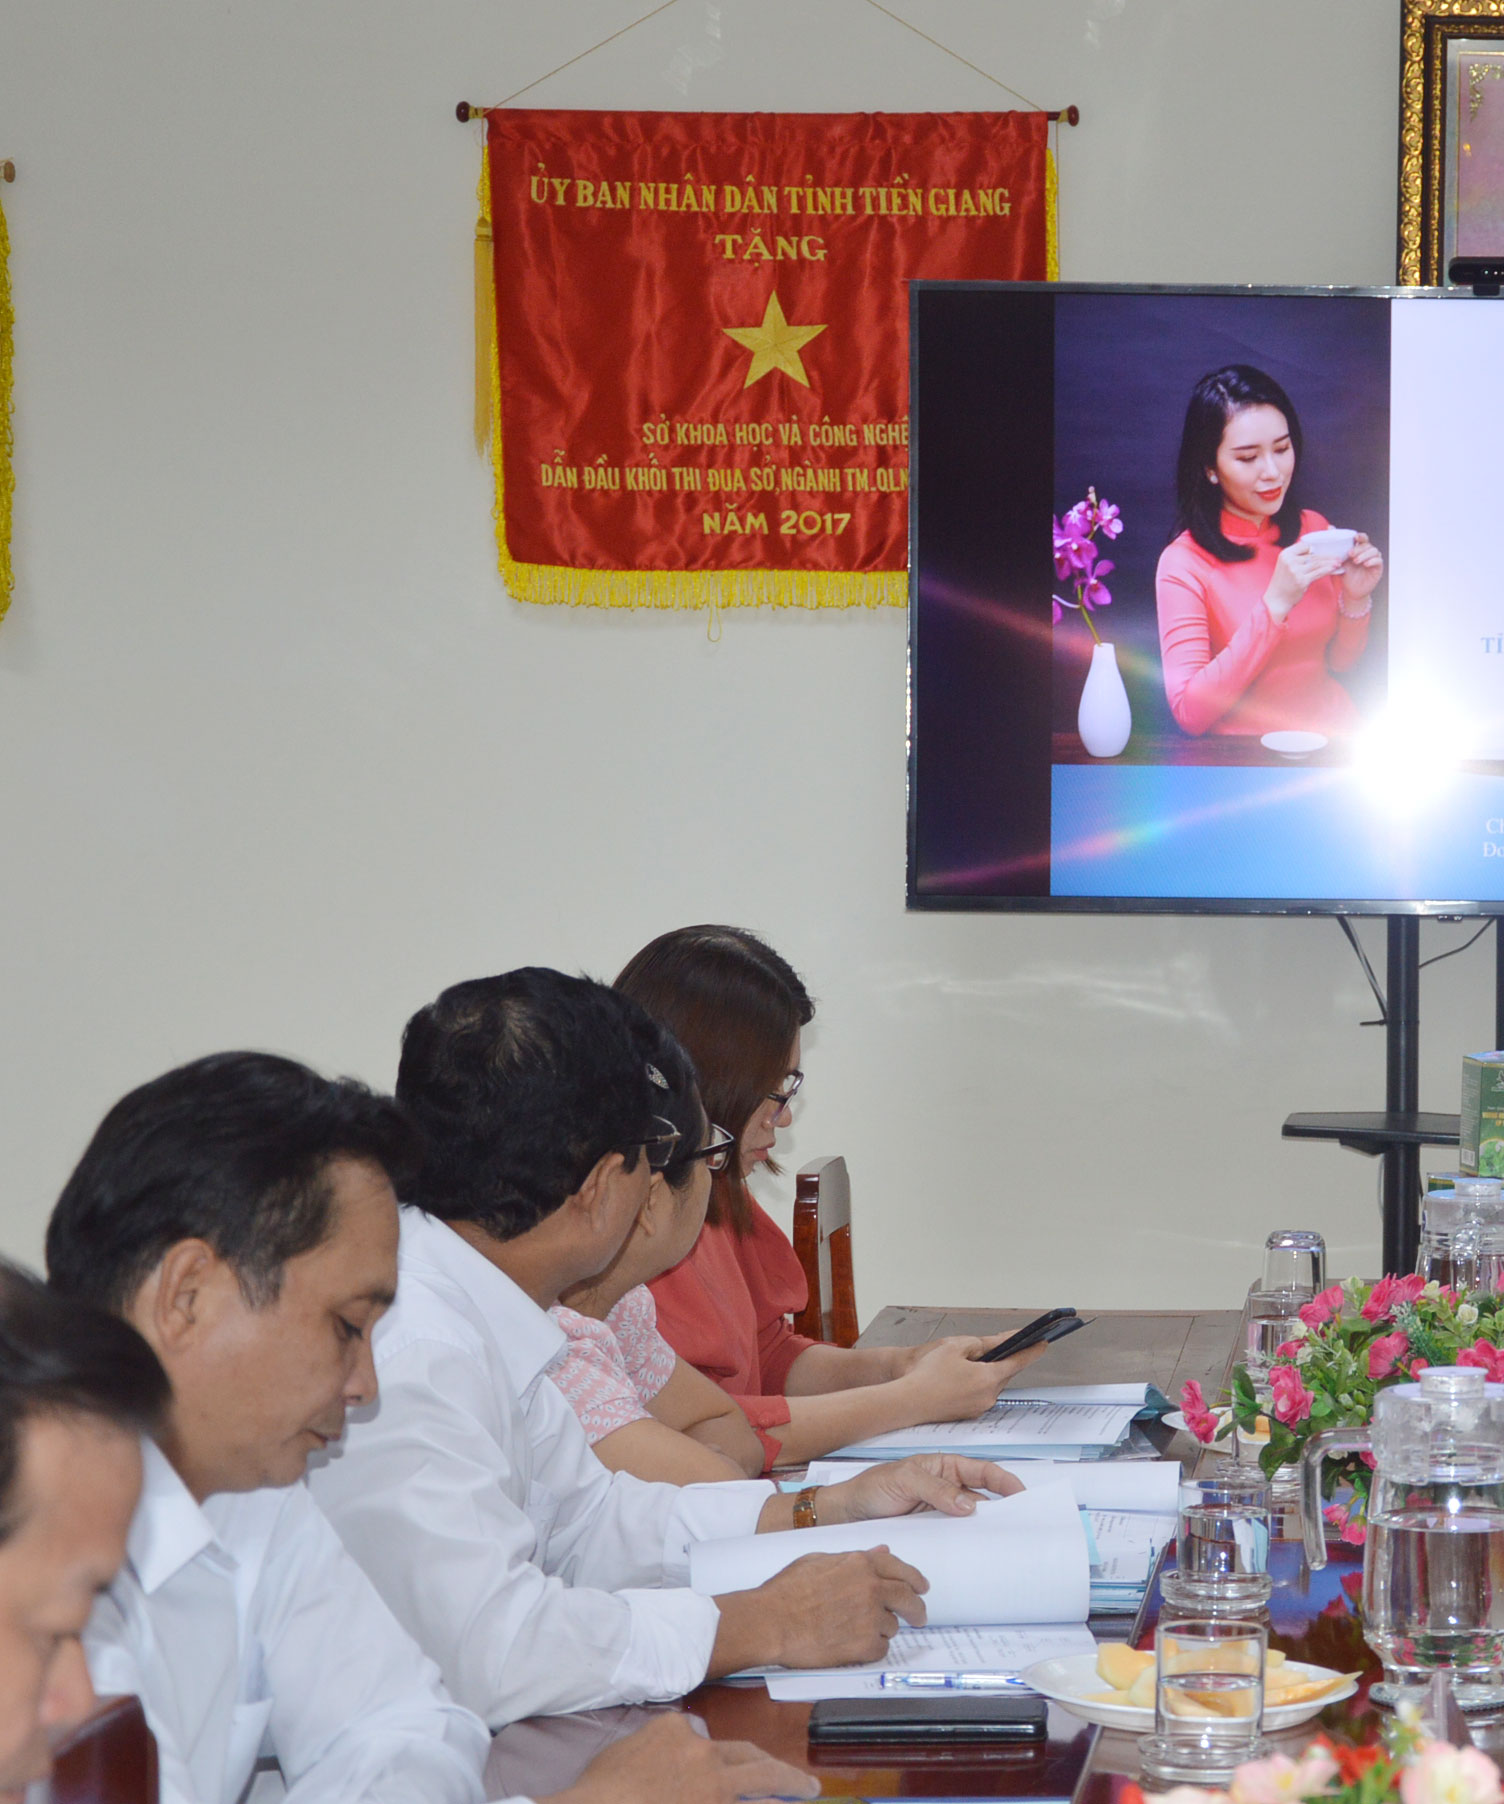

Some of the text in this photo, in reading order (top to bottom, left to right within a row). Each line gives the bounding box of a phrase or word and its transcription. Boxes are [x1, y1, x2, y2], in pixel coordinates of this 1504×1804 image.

[532, 163, 1010, 216] ỦY BAN NHÂN DÂN TỈNH TIỀN GIANG
[715, 228, 827, 266] TẶNG
[643, 414, 669, 444] SỞ
[677, 424, 728, 445] KHOA
[736, 424, 773, 450] HỌC
[779, 416, 801, 445] VÀ
[810, 416, 857, 446] CÔNG
[542, 450, 577, 488] DẪN
[584, 455, 619, 489] ĐẦU
[626, 453, 667, 490] KHỐI
[672, 468, 701, 490] THI
[707, 469, 746, 491] ĐUA
[704, 503, 851, 534] NĂM 2017
